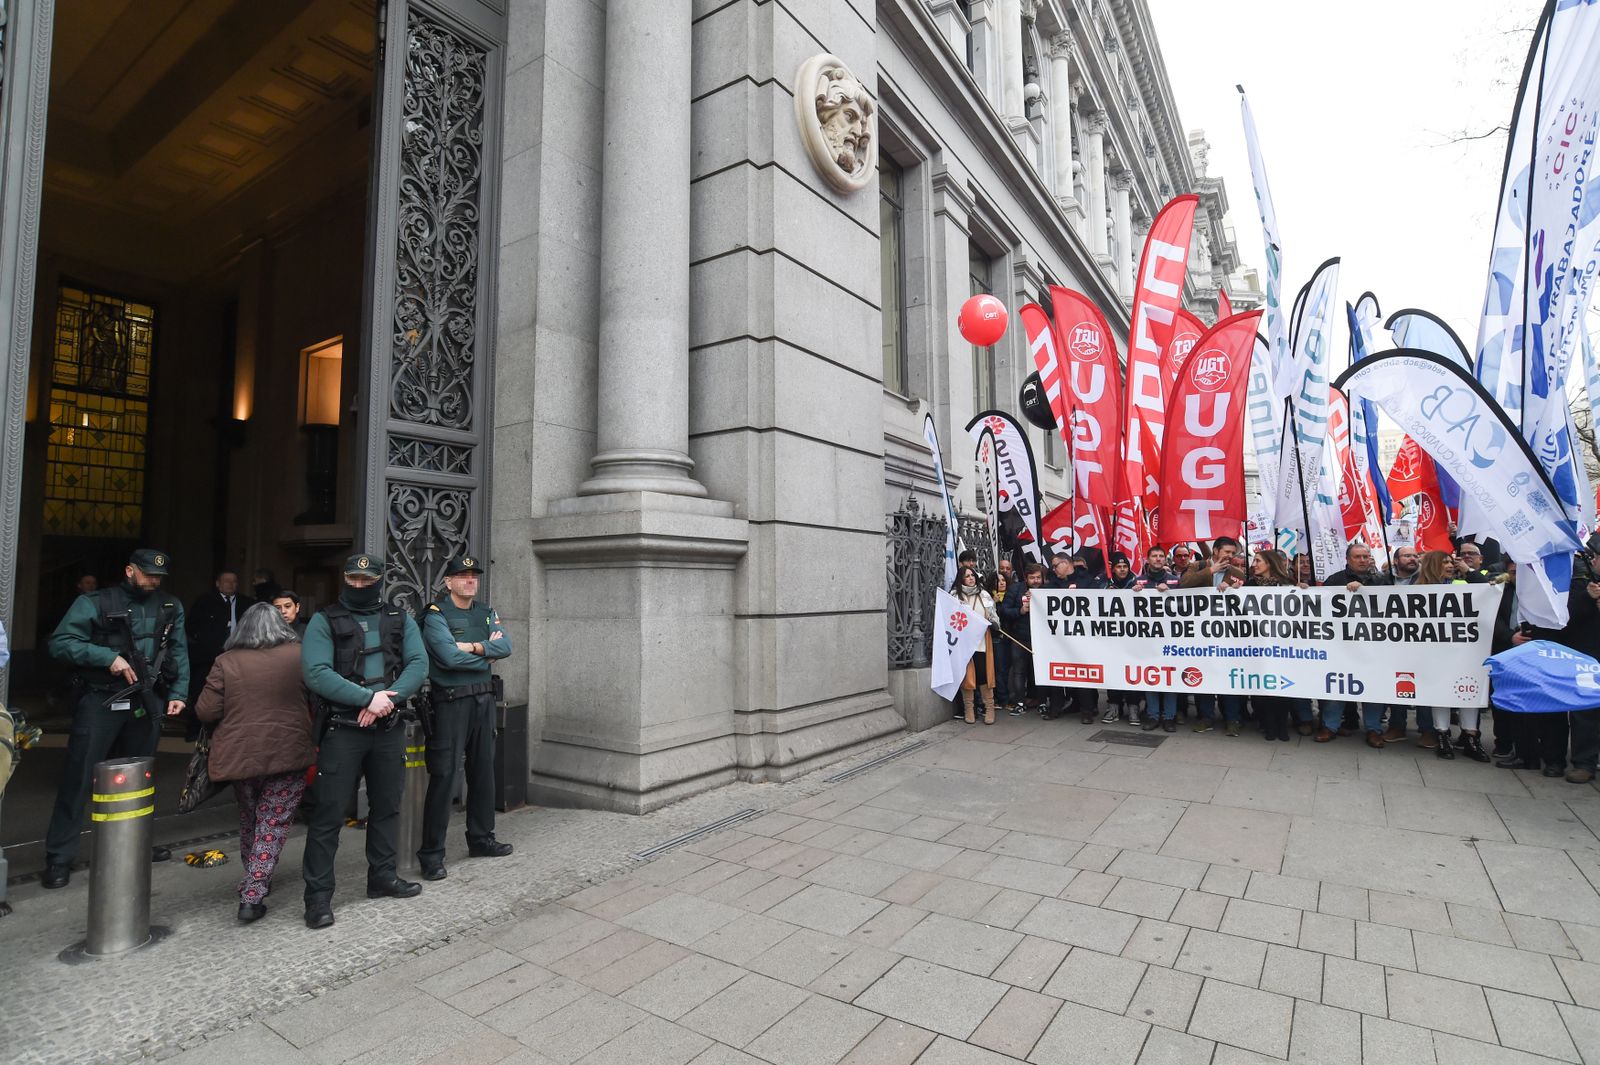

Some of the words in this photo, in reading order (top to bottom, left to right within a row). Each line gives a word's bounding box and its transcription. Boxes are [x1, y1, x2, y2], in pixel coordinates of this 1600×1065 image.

[1554, 112, 1577, 174] CIC
[1198, 356, 1225, 375] UGT
[1180, 392, 1230, 538] UGT
[1047, 596, 1090, 616] POR
[1098, 596, 1130, 617] LA
[1134, 589, 1322, 617] RECUPERACIÓN
[1332, 593, 1480, 618] SALARIAL
[1047, 620, 1057, 635] Y
[1063, 620, 1085, 636] LA
[1089, 620, 1165, 638] MEJORA
[1171, 621, 1195, 638] DE
[1201, 620, 1335, 640] CONDICIONES
[1342, 622, 1479, 643] LABORALES
[1162, 644, 1328, 661] #SectorFinancieroEnLucha
[1053, 666, 1099, 680] CCOO
[1125, 665, 1177, 686] UGT
[1229, 668, 1277, 690] fine
[1326, 672, 1365, 695] fib
